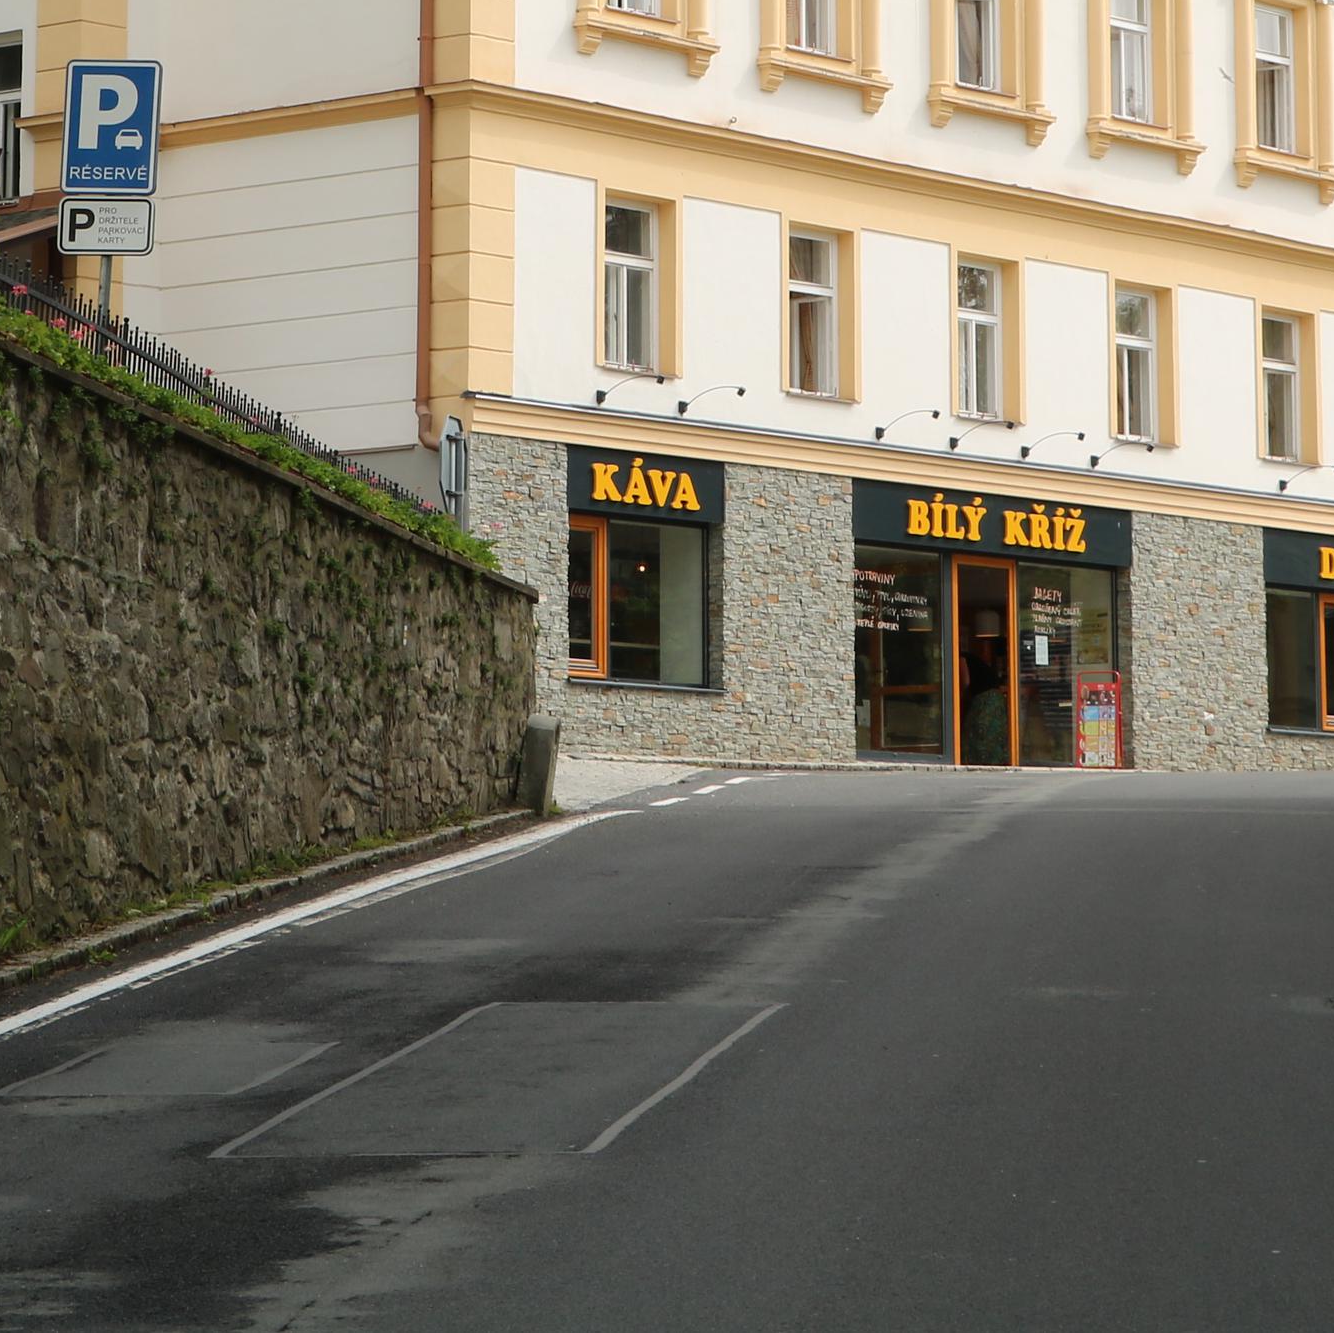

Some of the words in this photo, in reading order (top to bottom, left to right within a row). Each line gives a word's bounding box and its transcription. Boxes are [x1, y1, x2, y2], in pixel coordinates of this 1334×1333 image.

[77, 73, 139, 150] P
[69, 164, 148, 181] RÉSERVÉ
[98, 206, 117, 215] PRO
[68, 208, 95, 243] P
[98, 215, 139, 225] DRŽITELE
[98, 225, 146, 236] PARKOVACÍ
[97, 236, 126, 245] KARTY
[591, 457, 701, 511] KÁVA
[906, 492, 988, 542] BÍLÝ
[1002, 503, 1087, 553] KŘÍŽ
